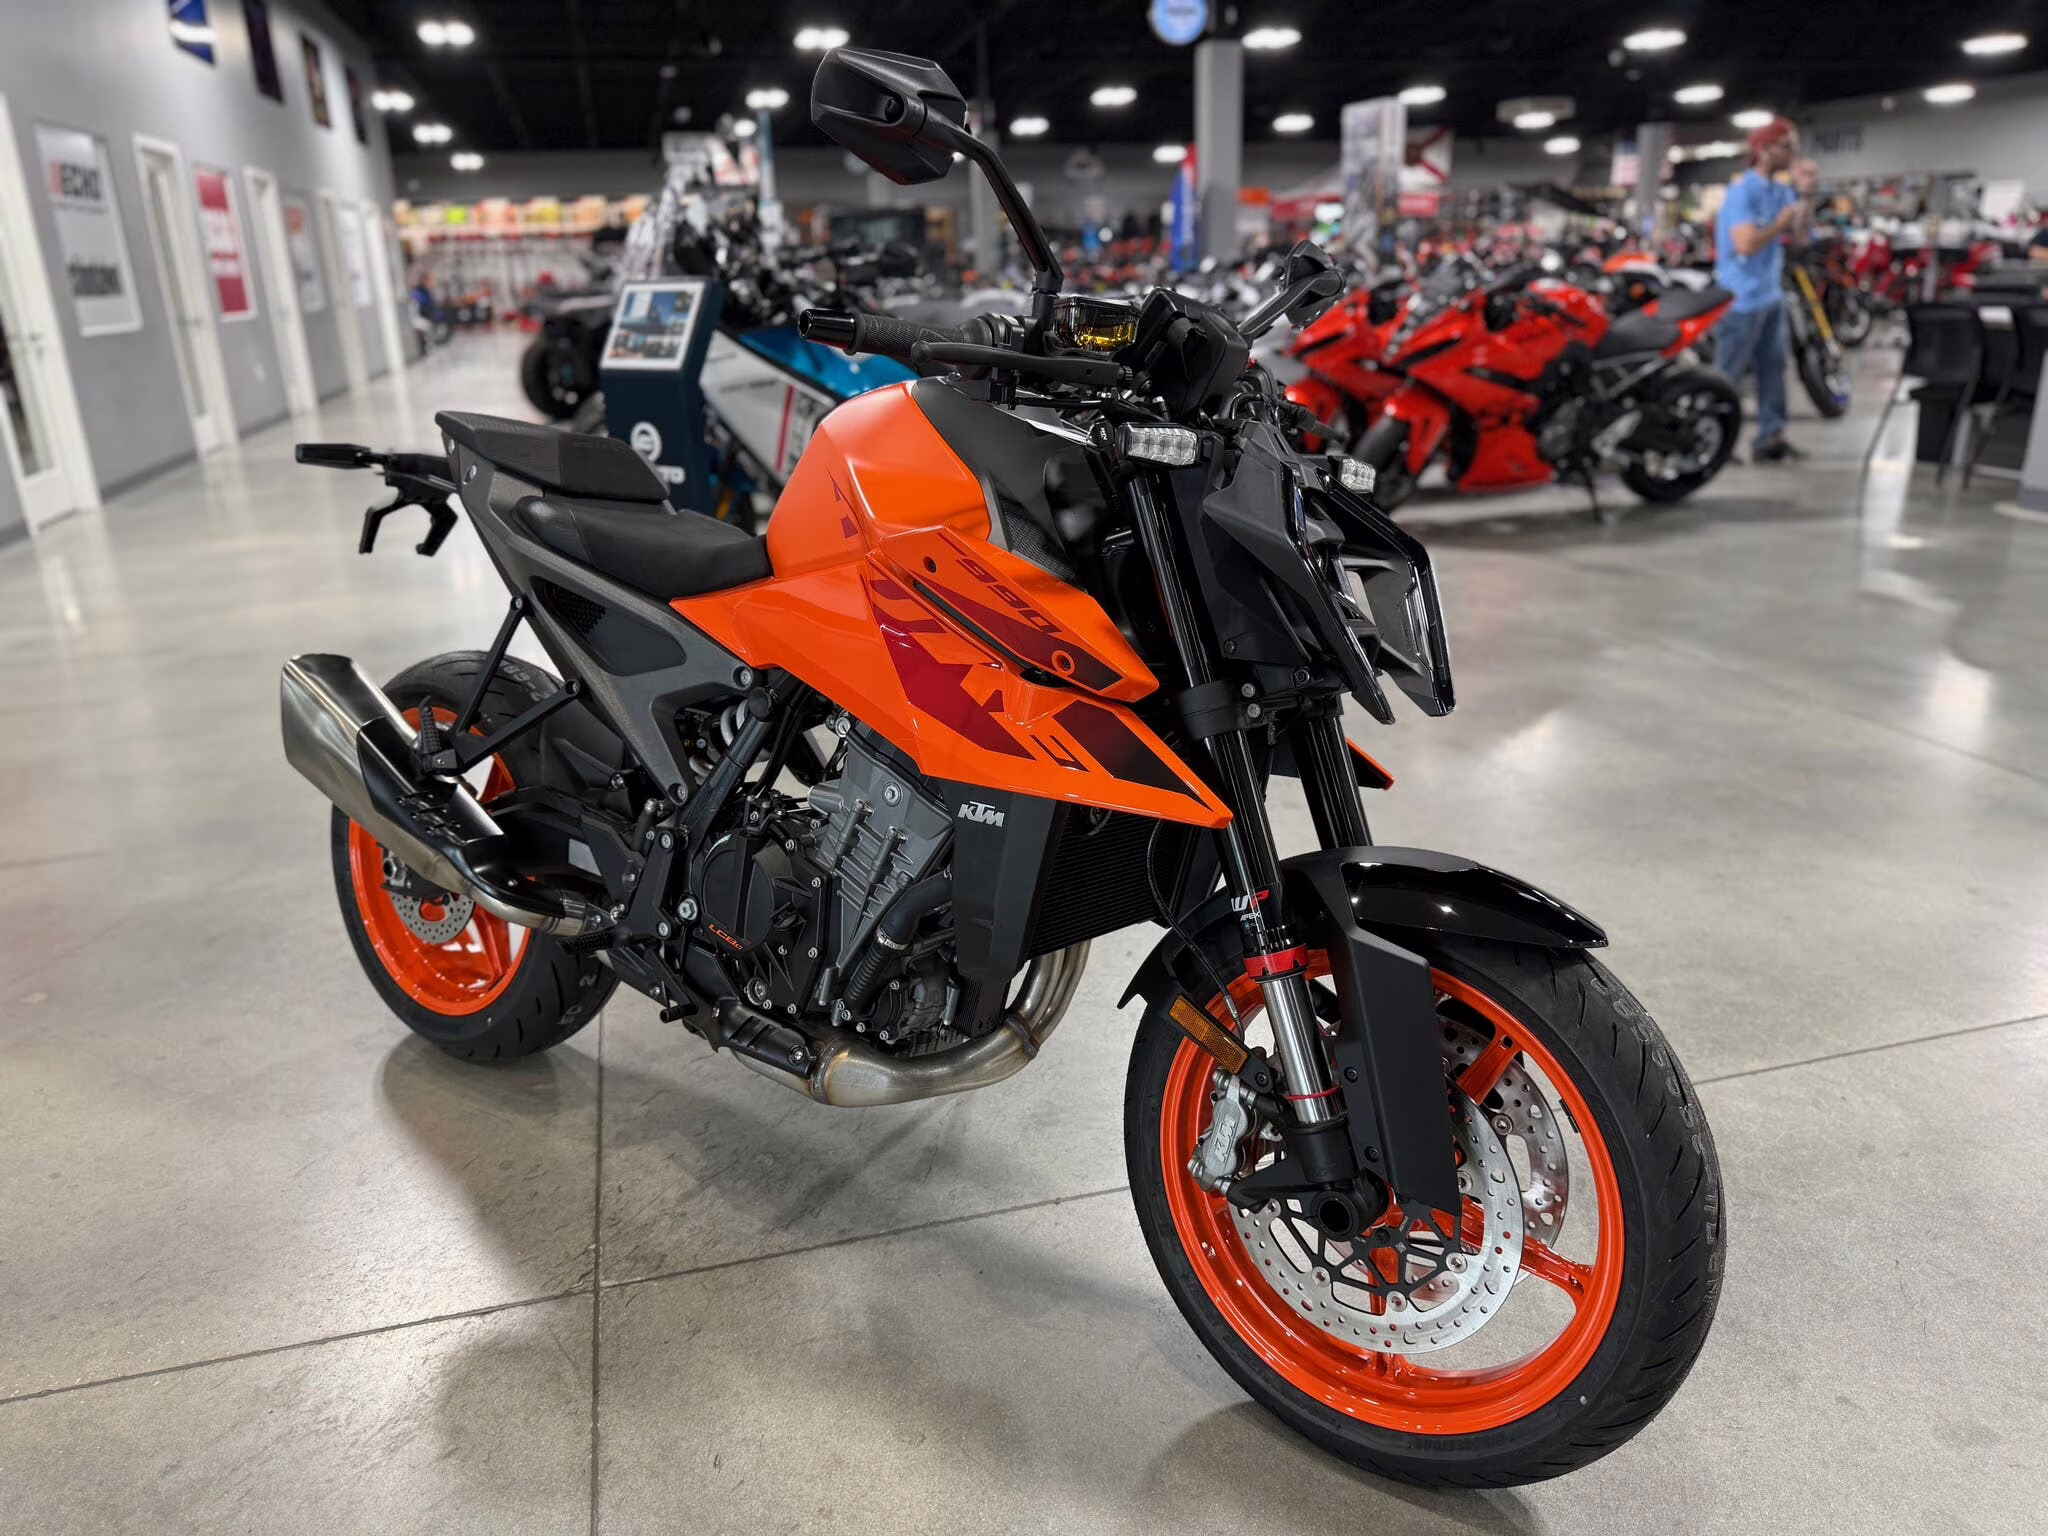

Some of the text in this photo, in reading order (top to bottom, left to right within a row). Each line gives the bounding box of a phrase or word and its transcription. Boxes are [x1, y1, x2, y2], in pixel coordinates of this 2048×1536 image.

[955, 557, 1064, 635] 990
[958, 801, 1005, 828] KTM
[1214, 1113, 1237, 1163] KTM
